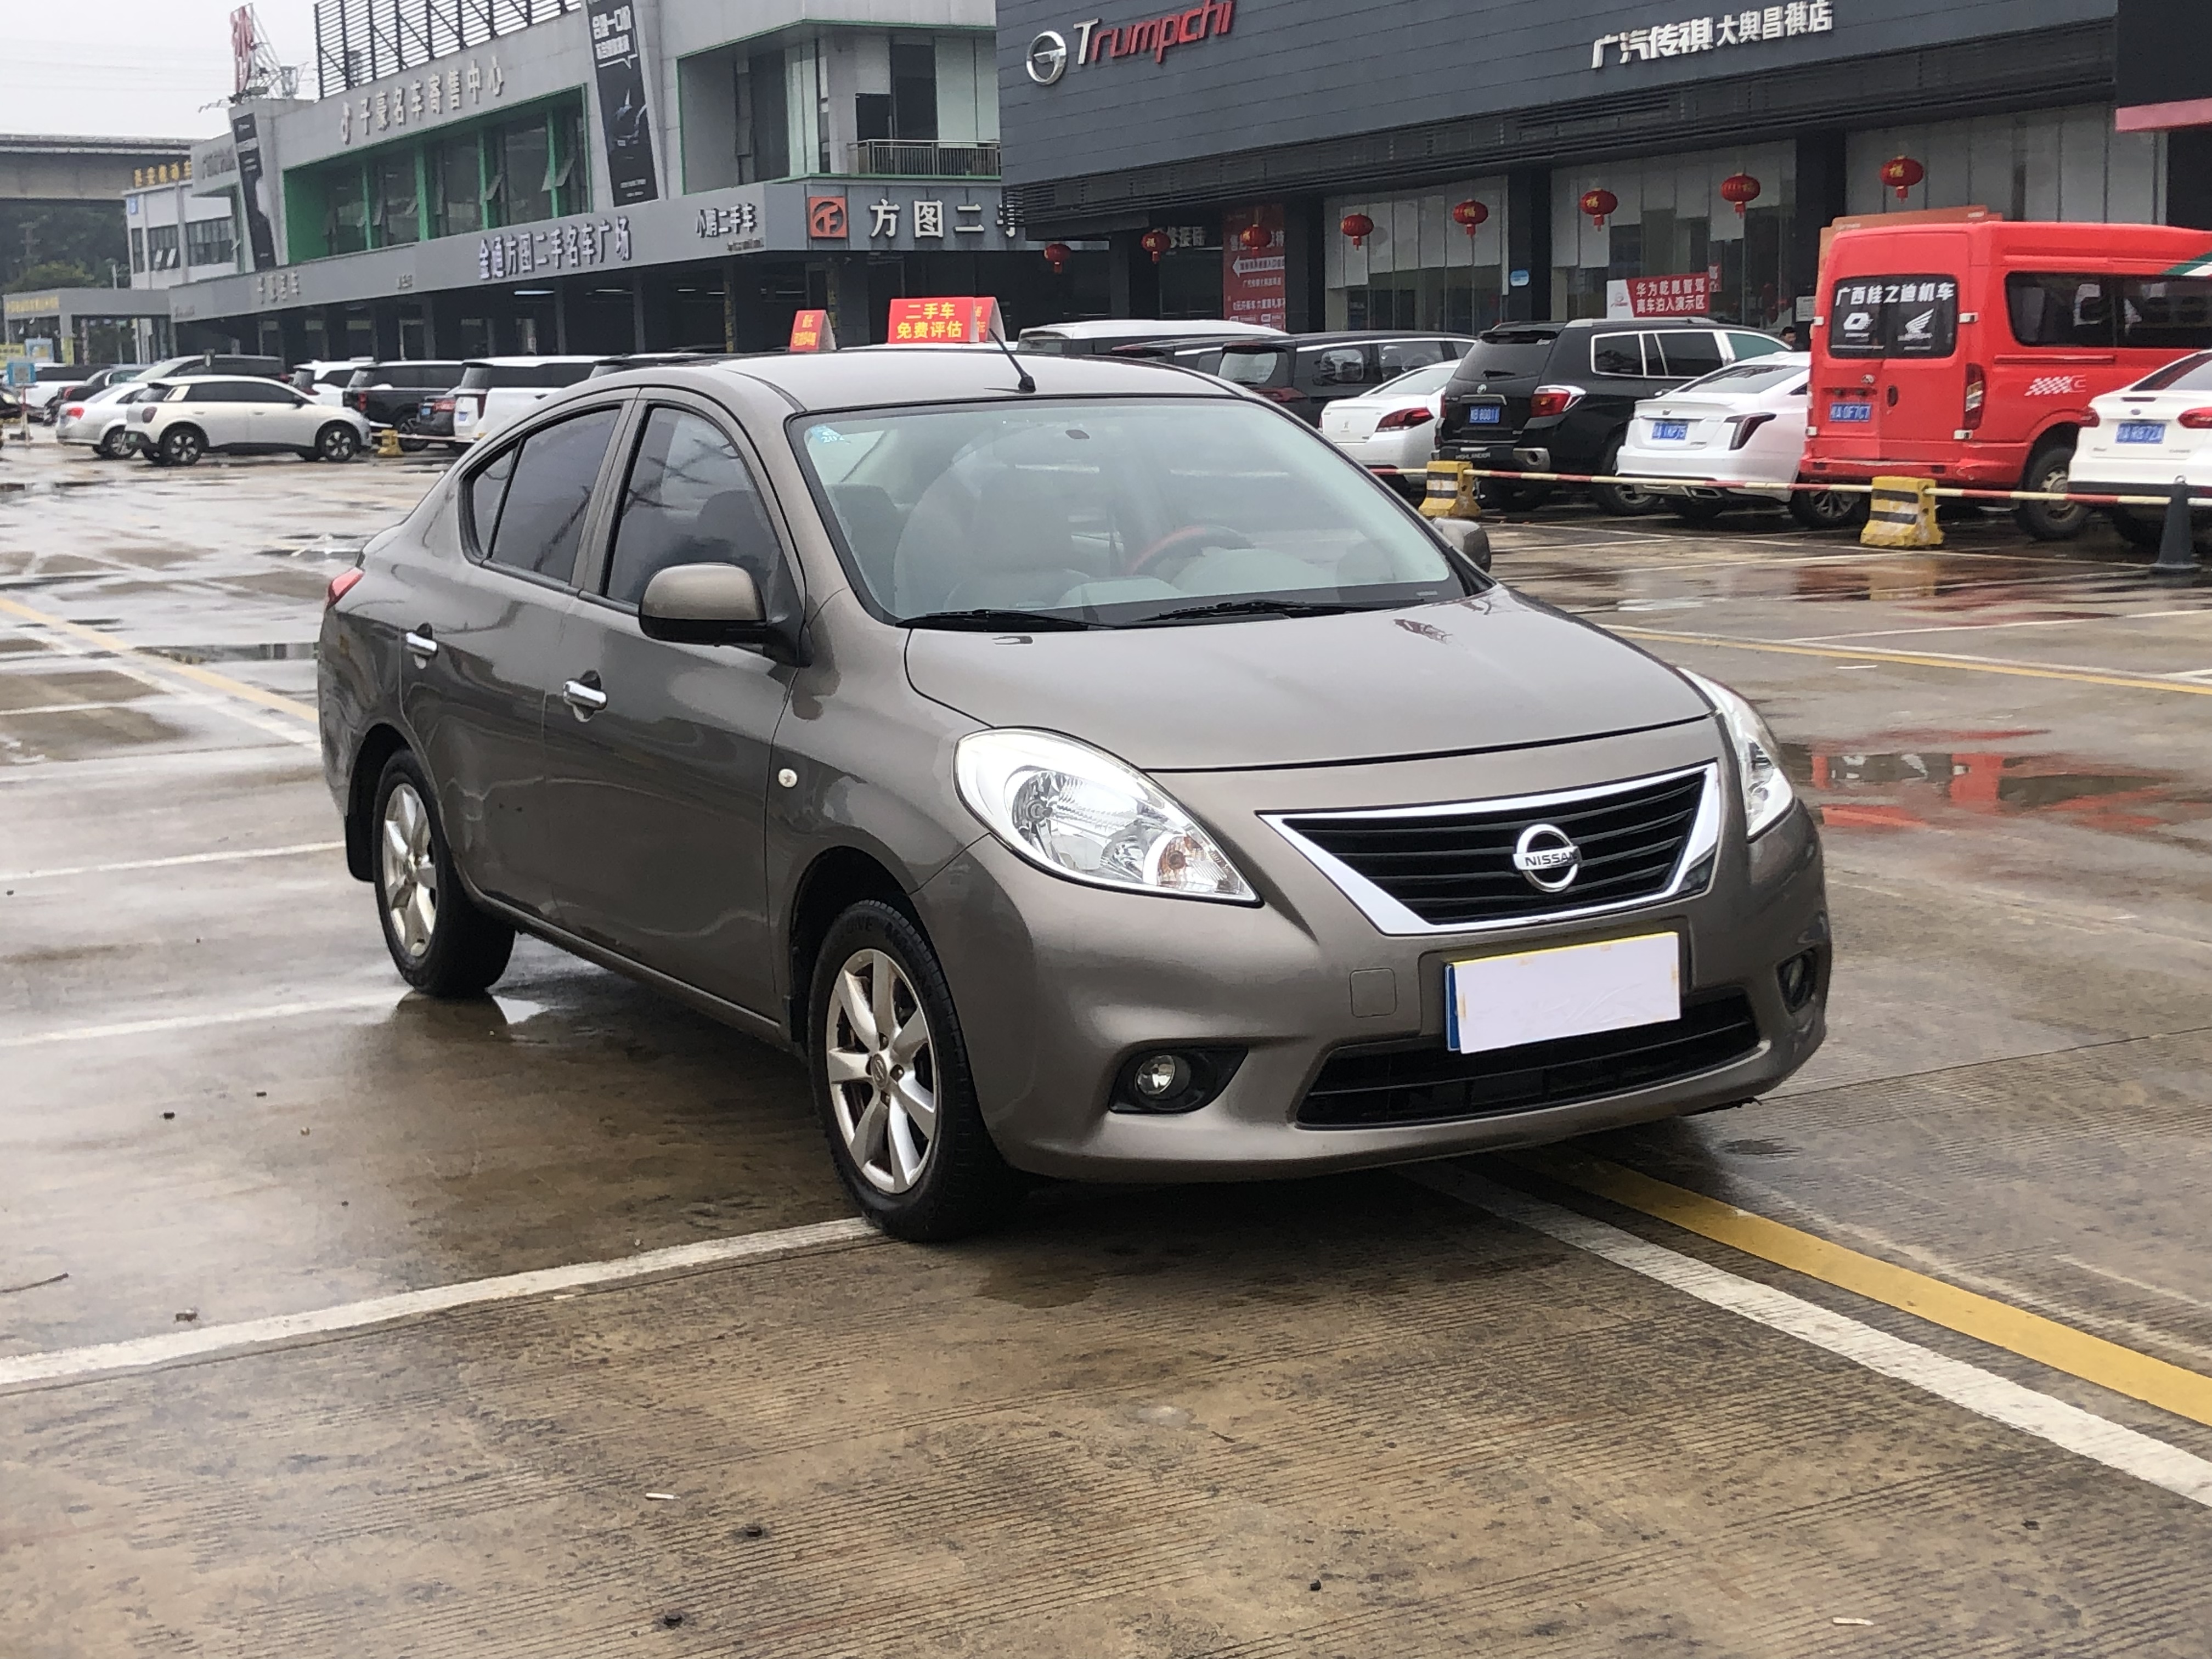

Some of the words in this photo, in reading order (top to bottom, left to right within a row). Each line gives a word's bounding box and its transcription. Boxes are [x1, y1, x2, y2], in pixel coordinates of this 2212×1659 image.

[1073, 0, 1234, 64] Trumpchi
[1591, 16, 1714, 69] 广汽传祺
[906, 302, 955, 319] 二手车
[896, 321, 963, 339] 免费评估
[1524, 851, 1578, 867] NISSAN
